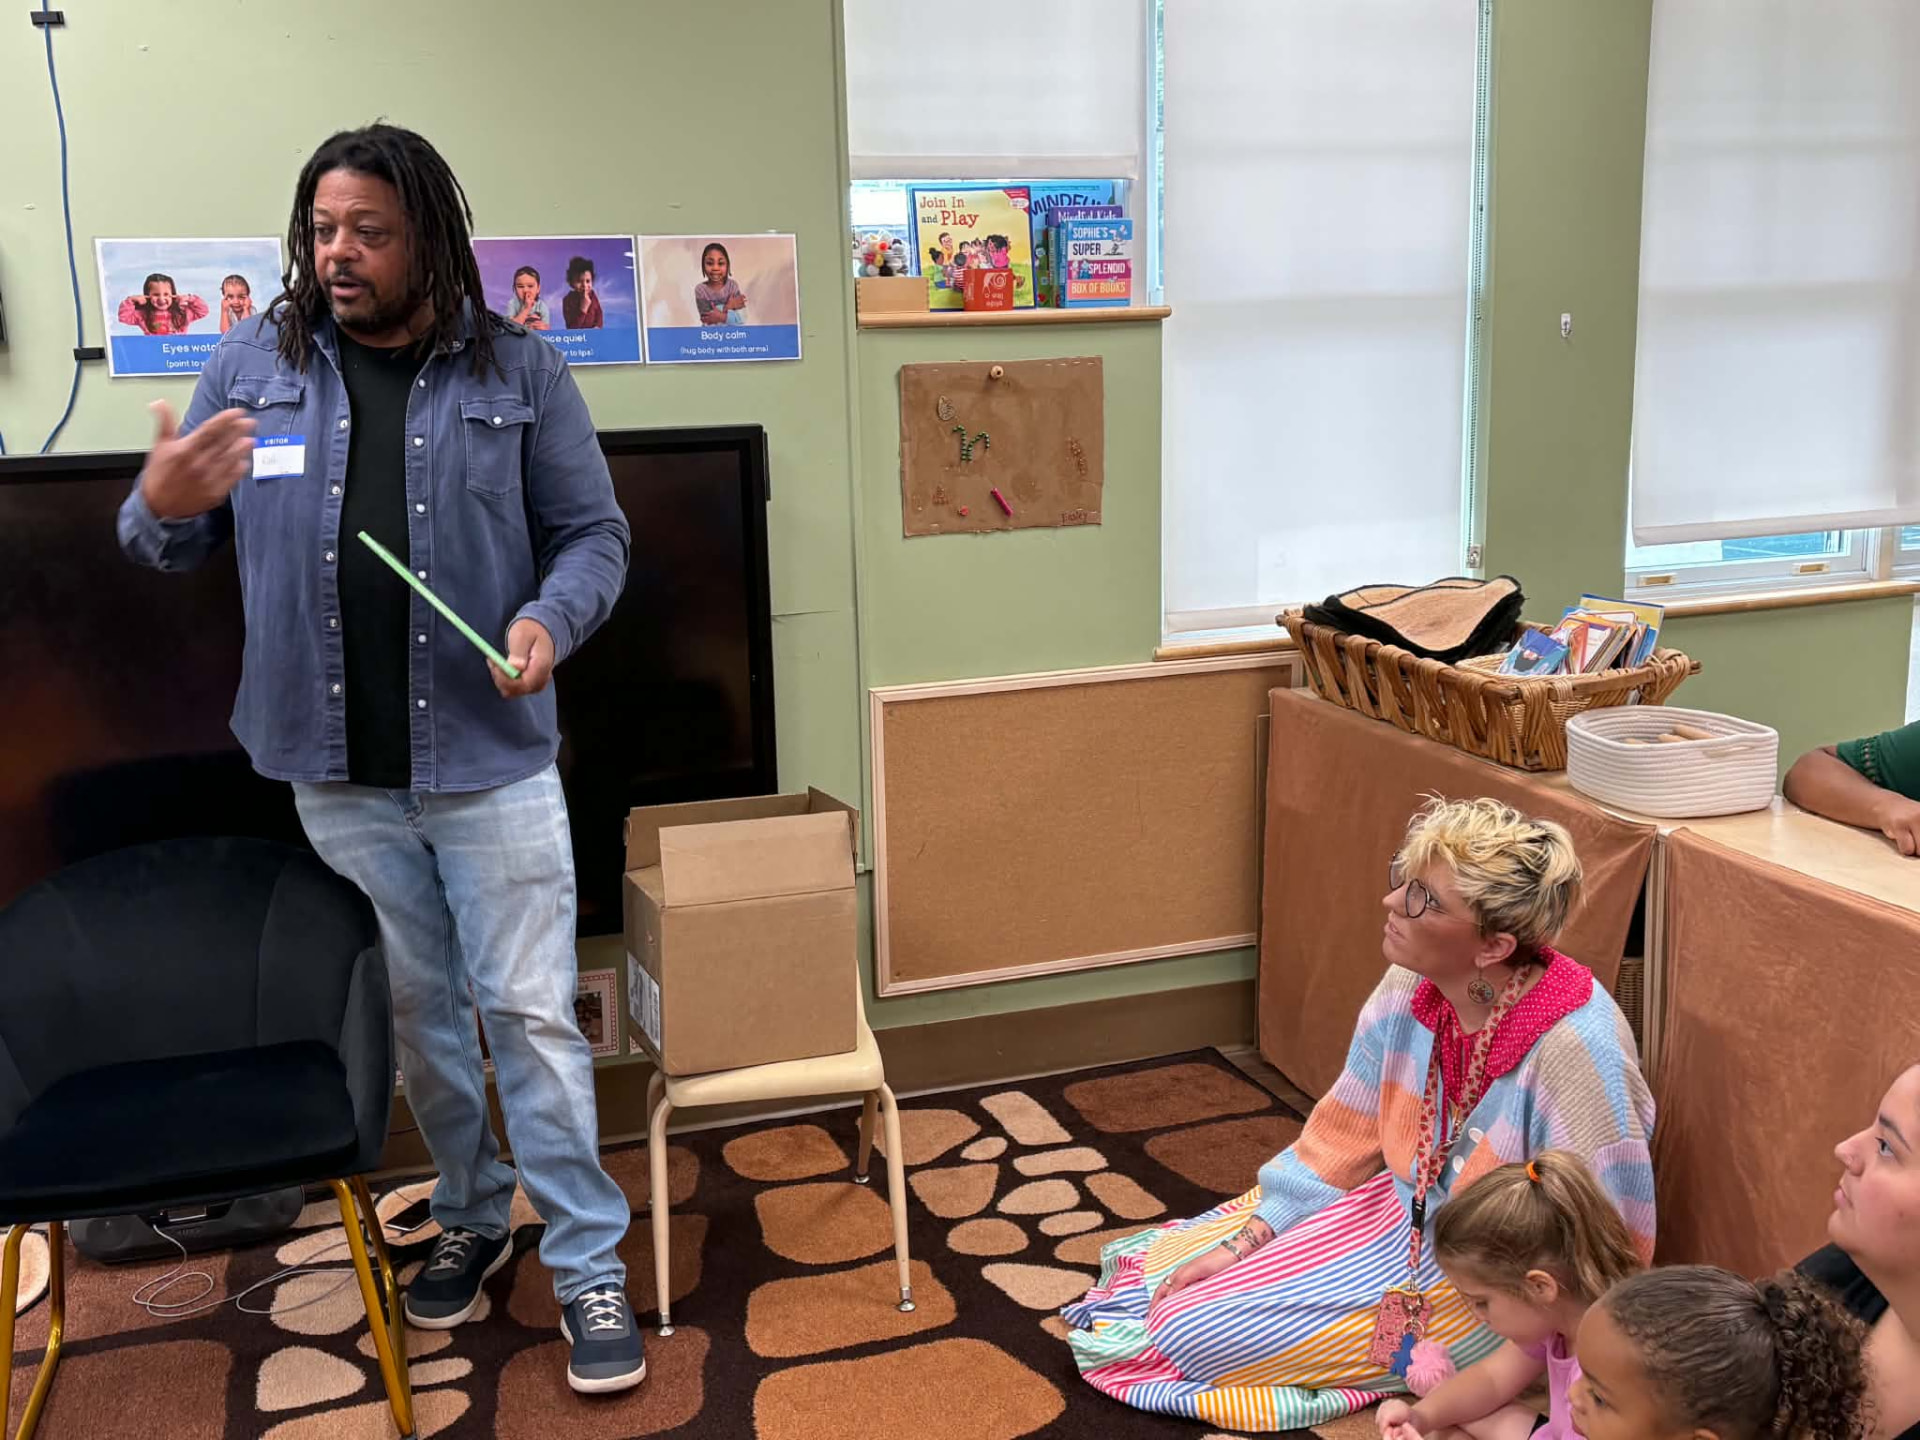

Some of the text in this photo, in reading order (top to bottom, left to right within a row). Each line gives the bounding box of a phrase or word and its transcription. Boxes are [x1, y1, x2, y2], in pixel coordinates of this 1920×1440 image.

[920, 196, 965, 208] Join In
[921, 210, 980, 228] and Play
[1072, 227, 1109, 239] SOPHIE'S
[1072, 243, 1101, 256] SUPER
[1088, 262, 1126, 274] SPLENDID
[1071, 281, 1126, 294] BOX OF BOOKS
[540, 332, 587, 344] oice quiet
[701, 330, 747, 341] Body calm
[162, 343, 189, 355] Eyes
[191, 360, 200, 368] to
